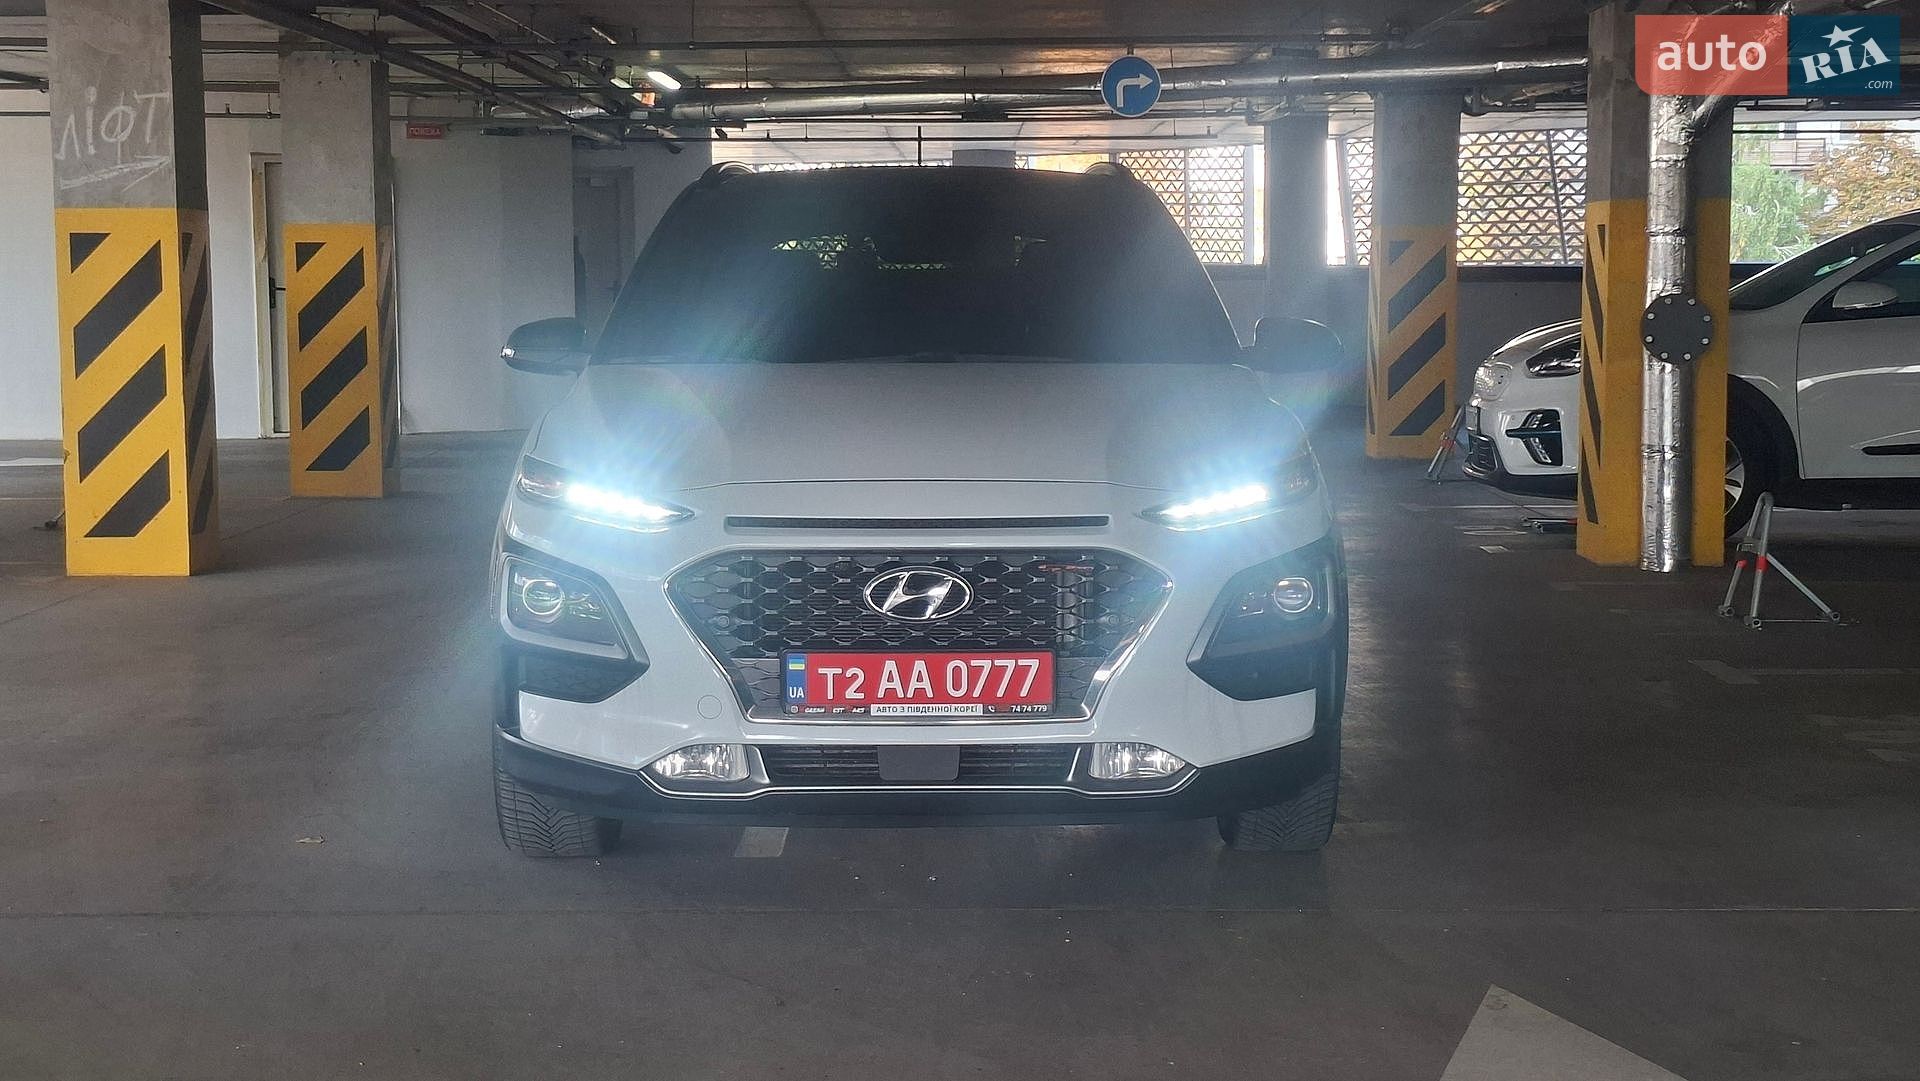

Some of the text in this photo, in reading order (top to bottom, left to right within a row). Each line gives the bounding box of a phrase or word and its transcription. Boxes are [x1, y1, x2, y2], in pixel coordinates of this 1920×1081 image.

[789, 687, 805, 698] UA
[817, 659, 1040, 700] T2 AA 0777
